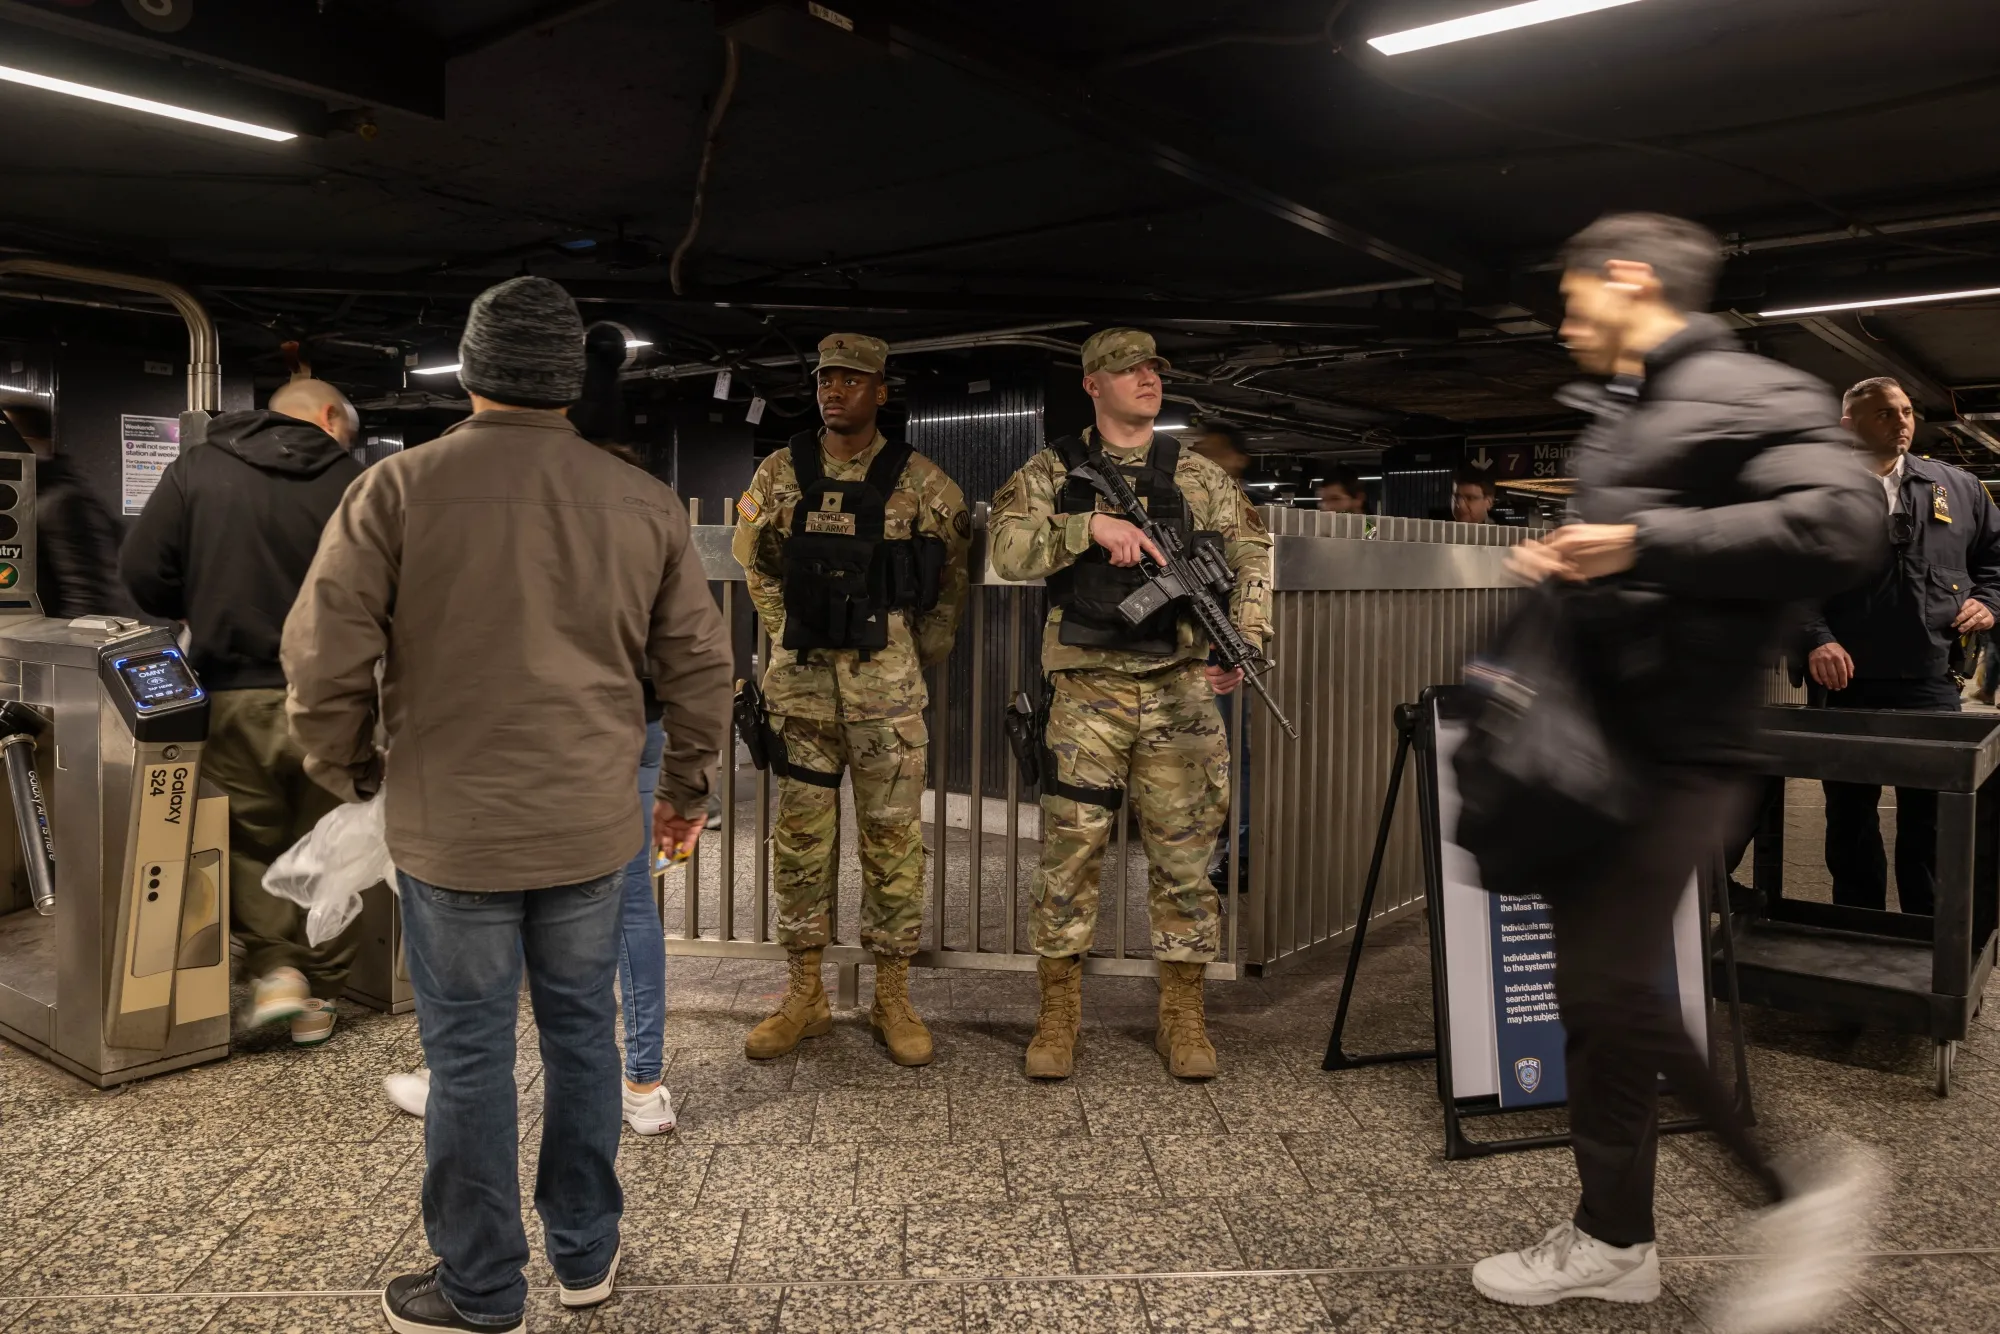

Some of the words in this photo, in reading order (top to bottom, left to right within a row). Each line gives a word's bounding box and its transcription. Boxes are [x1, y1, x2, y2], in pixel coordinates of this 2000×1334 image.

[1533, 444, 1573, 460] Main
[1507, 453, 1520, 471] 7
[1533, 461, 1556, 477] 34
[817, 513, 841, 521] POWELL
[825, 524, 849, 533] ARMY
[0, 545, 21, 559] try
[138, 668, 164, 678] OMNY
[28, 770, 42, 803] Galaxy
[150, 769, 167, 797] S24
[164, 767, 188, 825] Galaxy
[1500, 894, 1508, 902] to
[1500, 903, 1512, 912] the
[1512, 903, 1532, 911] Mass
[1502, 922, 1538, 932] Individuals
[1539, 922, 1554, 931] may
[1502, 933, 1538, 942] inspection
[1539, 932, 1552, 940] and
[1503, 952, 1540, 962] Individuals
[1541, 951, 1553, 960] will
[1504, 965, 1511, 973] to
[1512, 963, 1524, 972] the
[1525, 963, 1549, 972] system
[1505, 983, 1543, 993] Individuals
[1505, 993, 1530, 1003] search
[1530, 992, 1544, 1001] and
[1506, 1004, 1532, 1015] system
[1532, 1002, 1548, 1011] with
[1548, 1001, 1560, 1010] the
[1507, 1015, 1523, 1025] may
[1523, 1014, 1533, 1022] be
[1533, 1011, 1560, 1022] subject
[1518, 1060, 1538, 1070] POLICE
